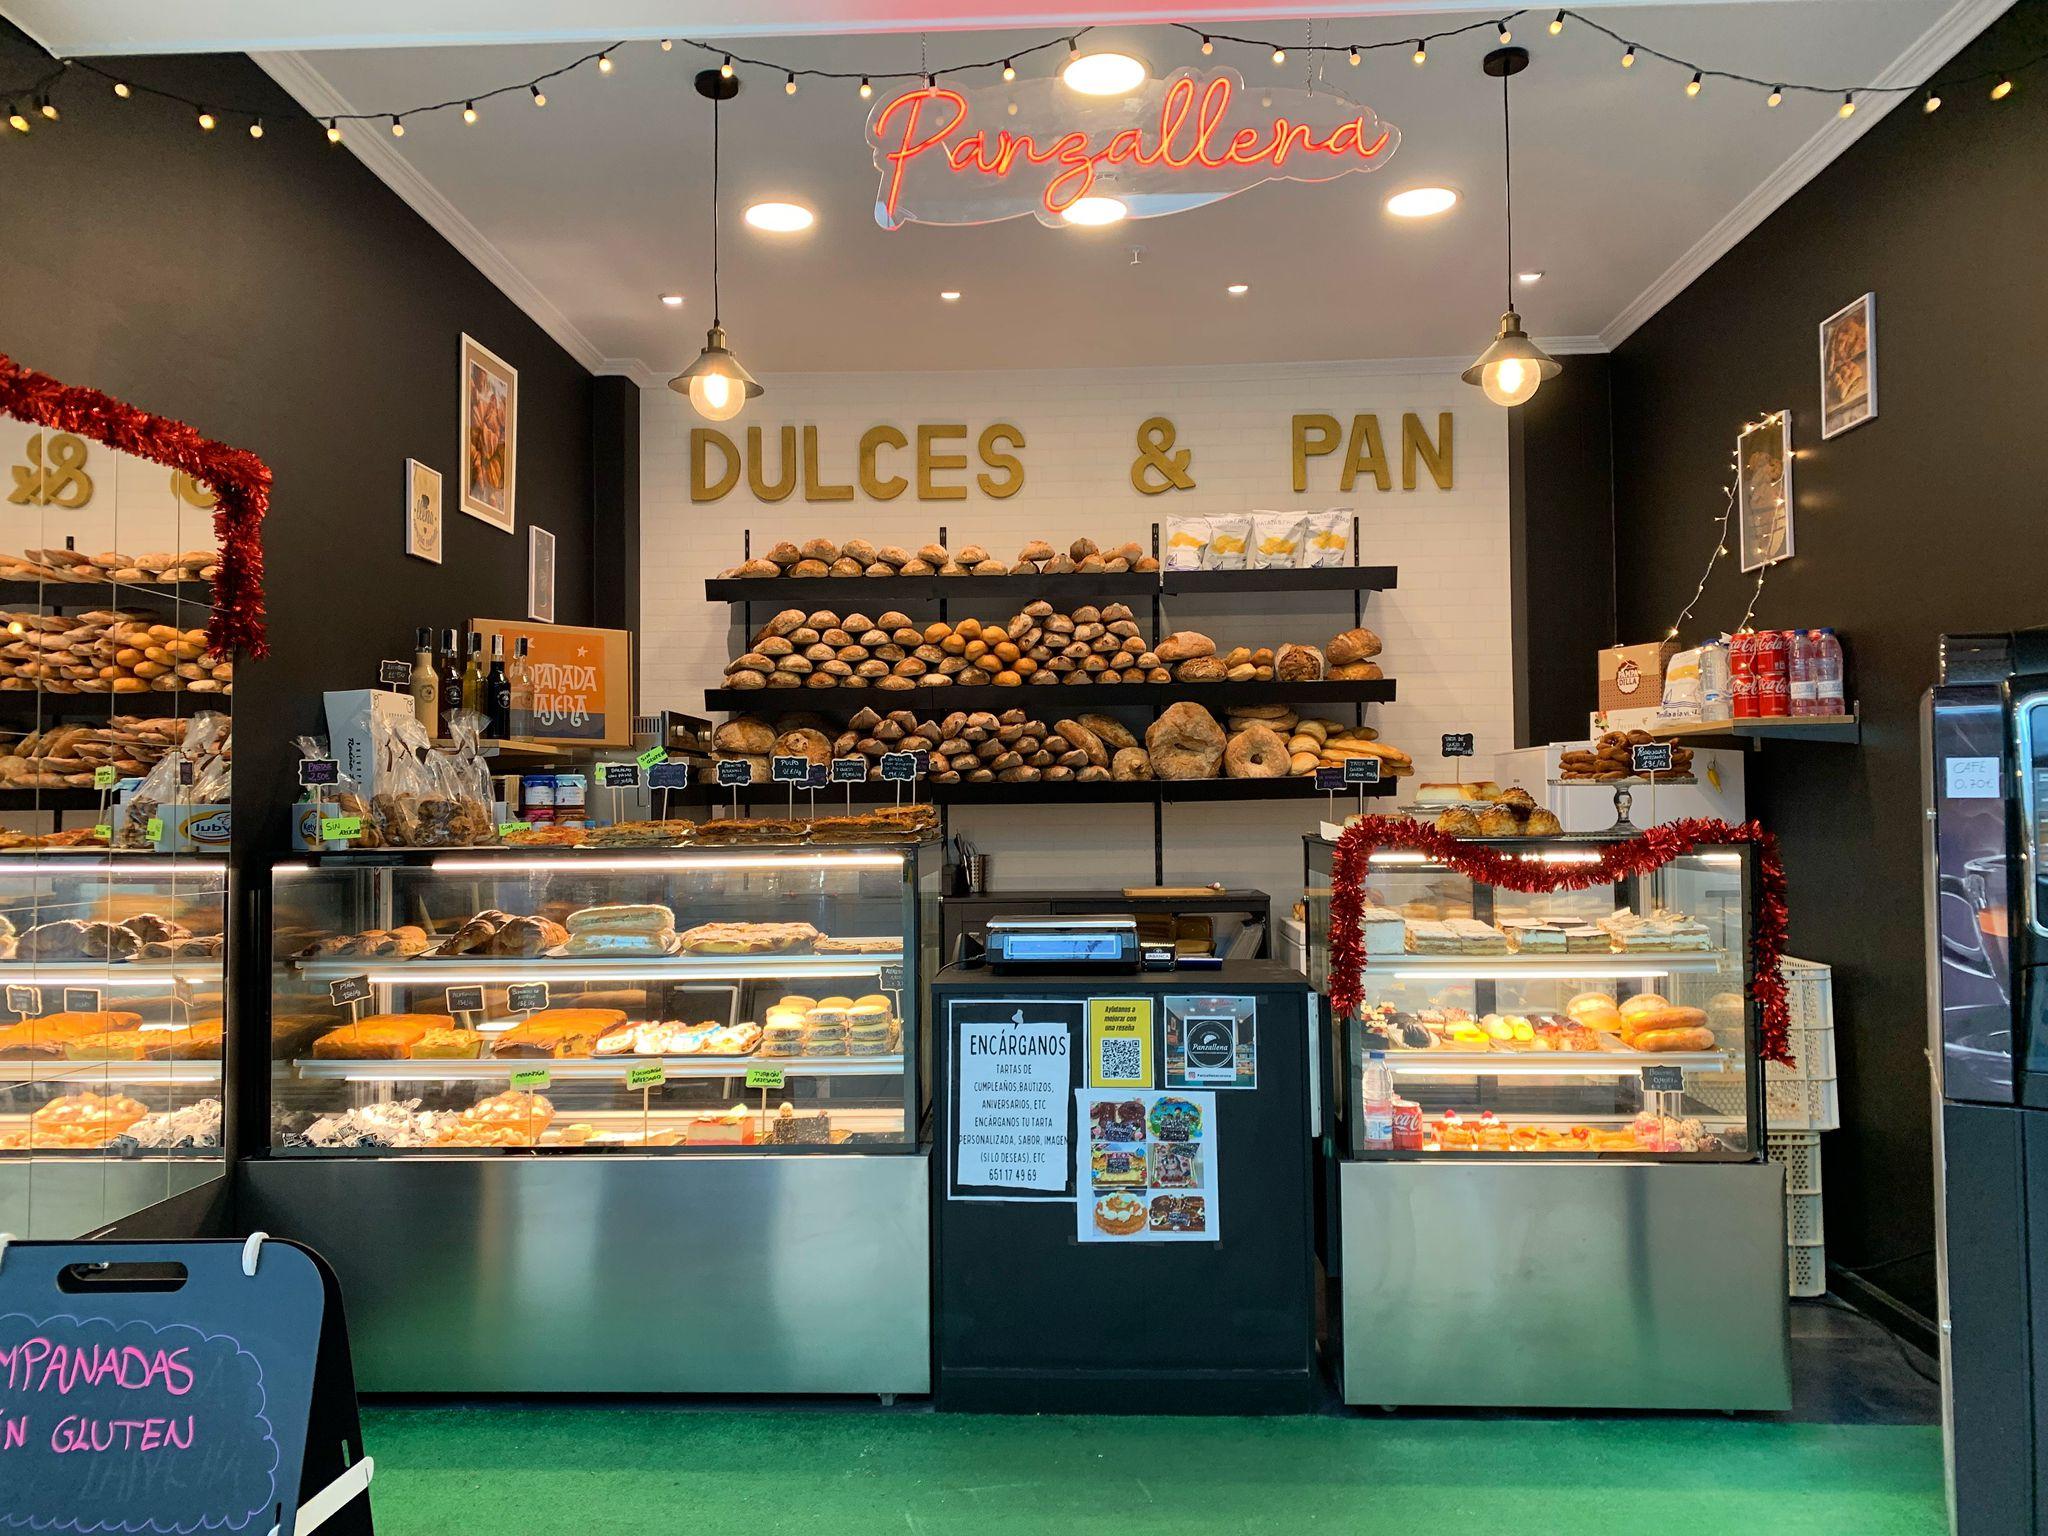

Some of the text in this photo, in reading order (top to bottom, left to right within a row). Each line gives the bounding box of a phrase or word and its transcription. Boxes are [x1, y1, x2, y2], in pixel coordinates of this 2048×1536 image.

[875, 76, 1391, 227] Panzallena
[690, 412, 1453, 502] DULCES & PAN
[1116, 1024, 1135, 1032] reseña
[970, 1029, 1066, 1056] ENCÁRGANOS
[996, 1064, 1032, 1075] TARTAS DE
[982, 1099, 1046, 1110] ANIVERSARIOS, ETC
[974, 1115, 1053, 1127] ENCÁRGANOS TU TARTA
[1018, 1135, 1043, 1146] SABOR,
[1033, 1152, 1046, 1163] ETC
[989, 1168, 1037, 1181] 651 17 49 69
[51, 1414, 195, 1453] GLUTEN
